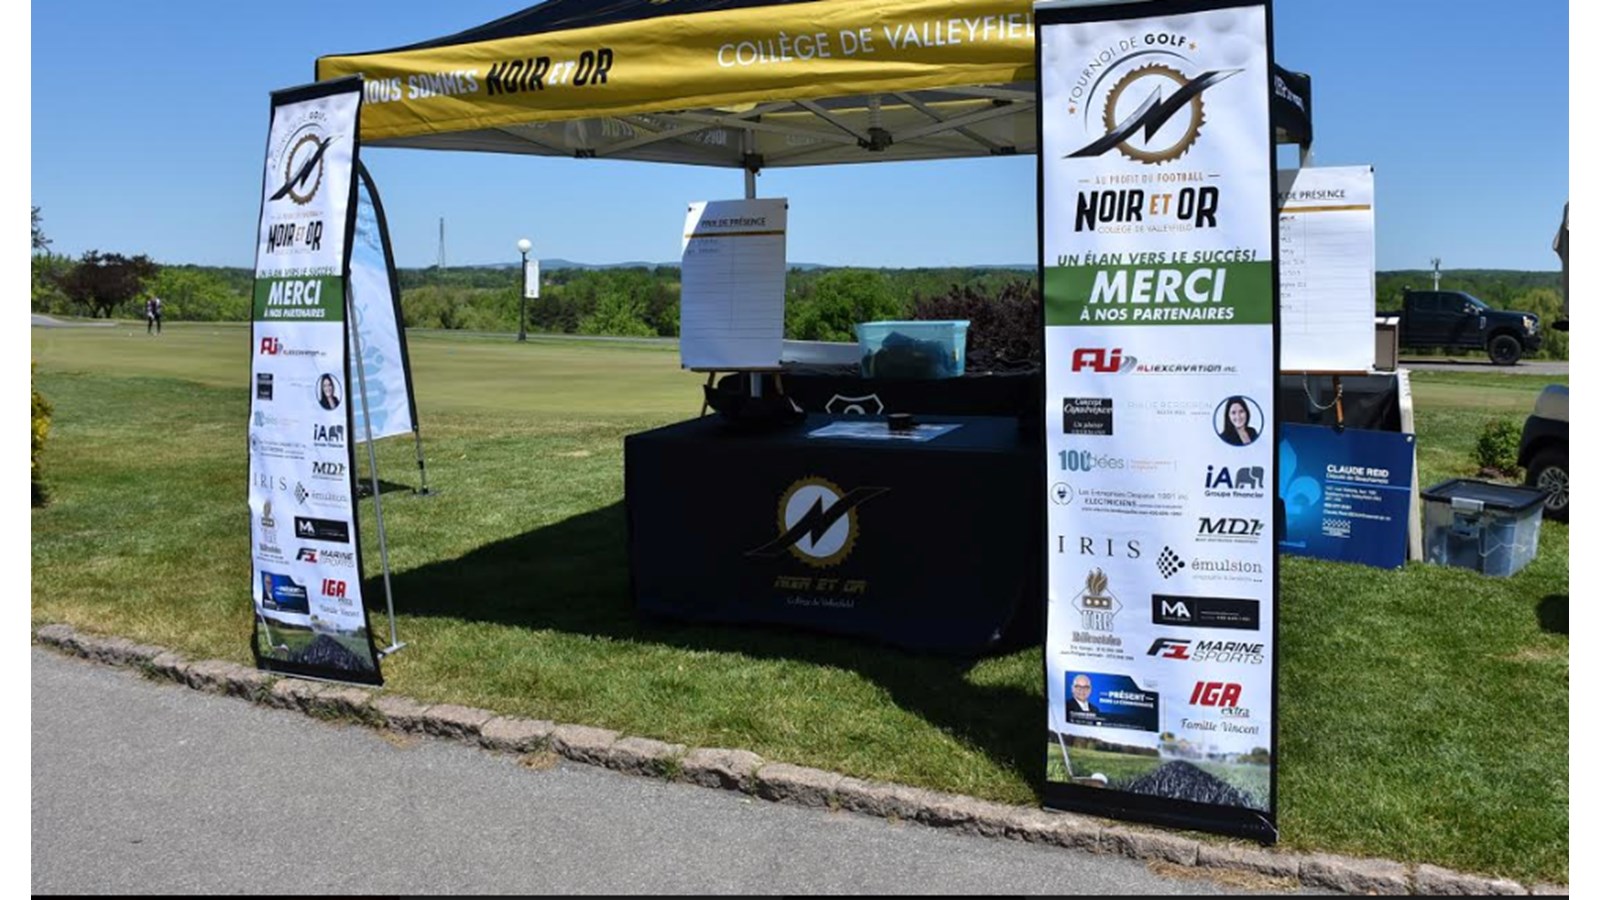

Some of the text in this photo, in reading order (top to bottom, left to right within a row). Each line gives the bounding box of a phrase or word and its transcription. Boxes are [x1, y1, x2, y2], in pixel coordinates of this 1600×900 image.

[717, 11, 1035, 68] COLLÈGE DE VALLEYFIEL
[408, 70, 478, 101] SOMMES
[487, 56, 549, 96] NOIR
[546, 61, 575, 85] ET
[571, 48, 614, 87] OR
[1068, 33, 1187, 105] TOURNOI DE GOLF
[1156, 171, 1204, 183] FOOTBALL
[1300, 189, 1345, 200] PRÉSENCE
[1075, 186, 1219, 232] NOIR ET OR
[266, 222, 295, 254] NOIR
[305, 220, 323, 252] OR
[1057, 246, 1256, 266] UN ÉLAN VERS LE SUCCÈS!
[267, 279, 321, 305] MERCI
[1089, 267, 1226, 304] MERCI
[1080, 306, 1235, 321] À NOS PARTENAIRES
[253, 471, 287, 491] IRIS
[1204, 464, 1234, 489] iA
[1327, 464, 1389, 479] CLAUDE REID
[1204, 490, 1264, 499] Groupe financier
[320, 549, 353, 560] MARINE
[1058, 535, 1140, 559] IRIS
[1191, 557, 1262, 573] émulsion
[321, 578, 346, 598] IGA
[1161, 600, 1191, 618] MA
[1196, 640, 1264, 654] MARINE
[1192, 650, 1264, 665] SPORTS
[1189, 681, 1242, 707] IGA
[1220, 706, 1250, 718] extra
[1180, 718, 1259, 735] Famille Vincent
